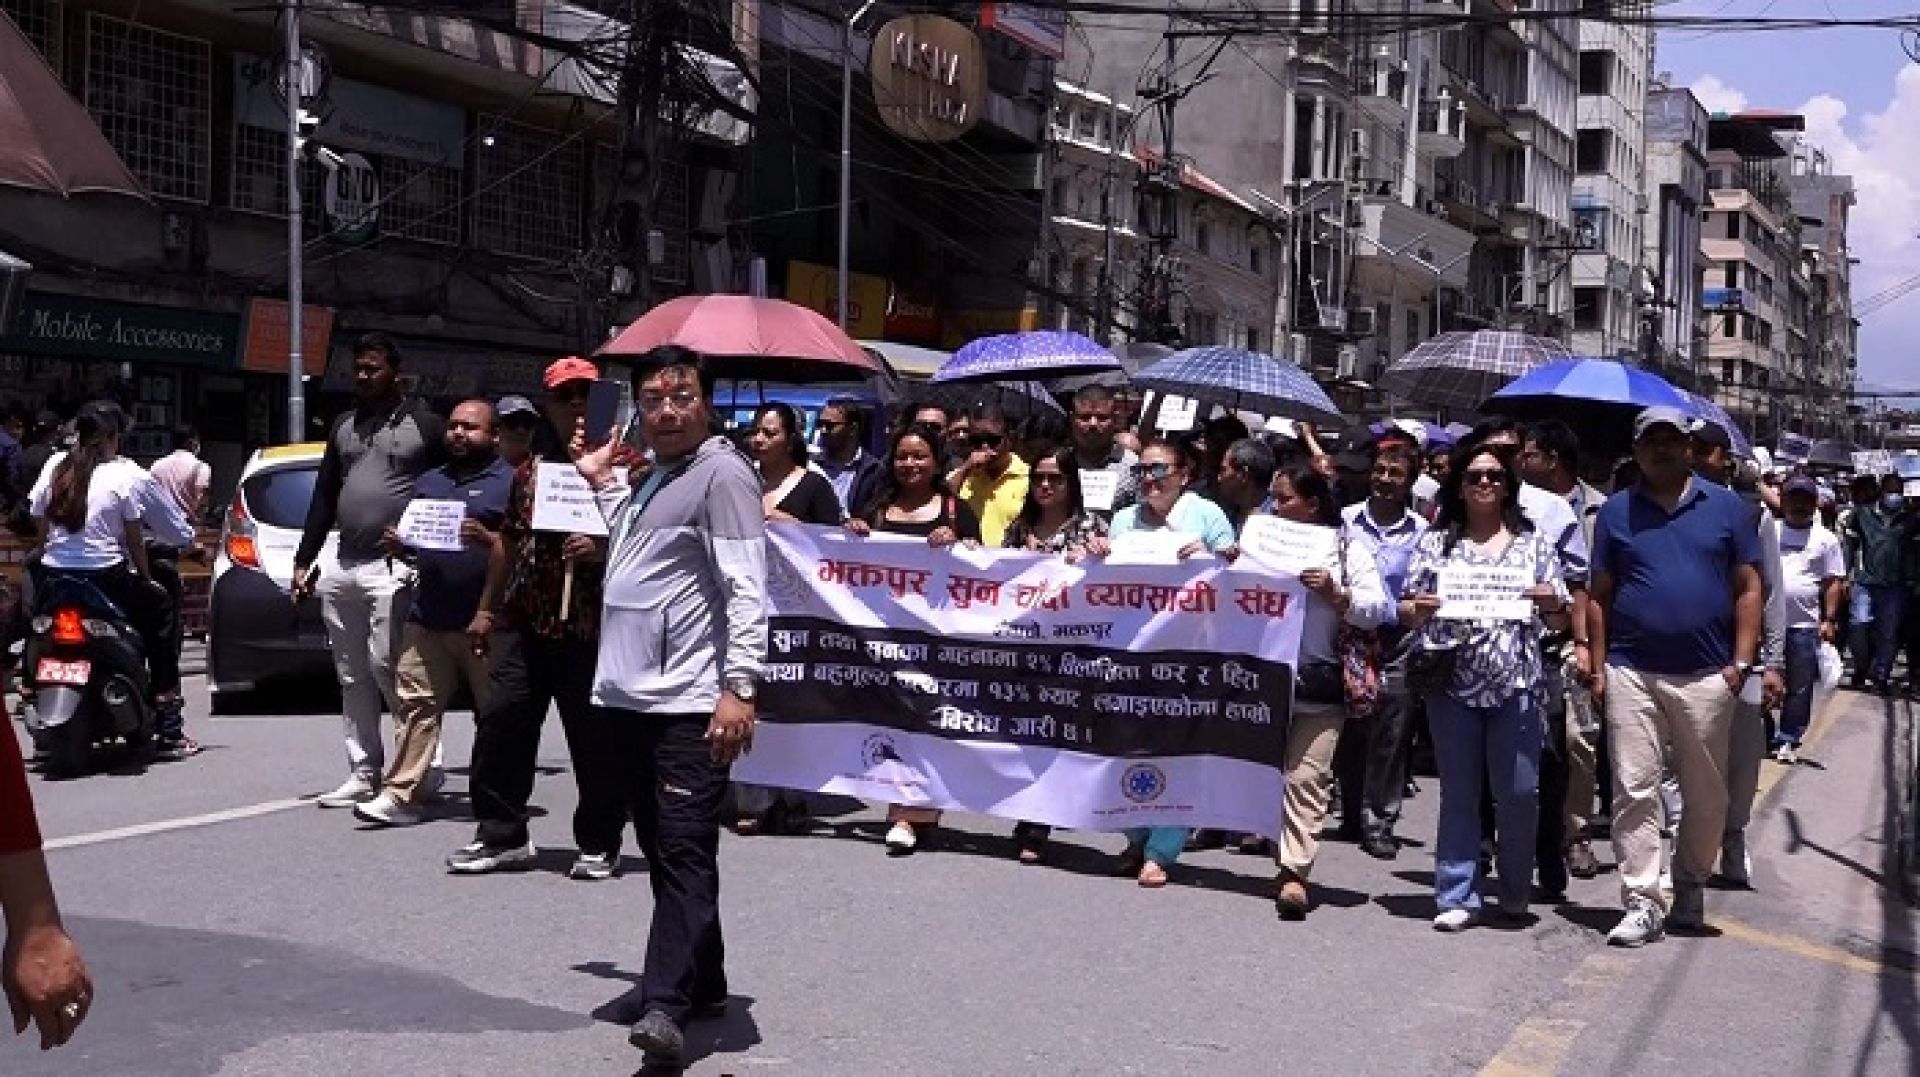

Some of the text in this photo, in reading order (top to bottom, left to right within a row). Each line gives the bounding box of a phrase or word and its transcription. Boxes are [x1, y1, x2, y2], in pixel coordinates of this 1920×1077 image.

[29, 309, 101, 341] Mobile
[108, 316, 223, 352] Accessories
[818, 559, 932, 598] भक्तपुर
[946, 575, 1004, 609] सुन
[1083, 580, 1218, 614] व्यवसायी
[1233, 584, 1290, 618] संघ
[773, 629, 809, 653] सुन
[819, 631, 857, 651] तथा
[1151, 662, 1188, 684] कर
[1198, 666, 1211, 686] र
[1009, 714, 1057, 738] जारी
[1063, 722, 1078, 743] छ
